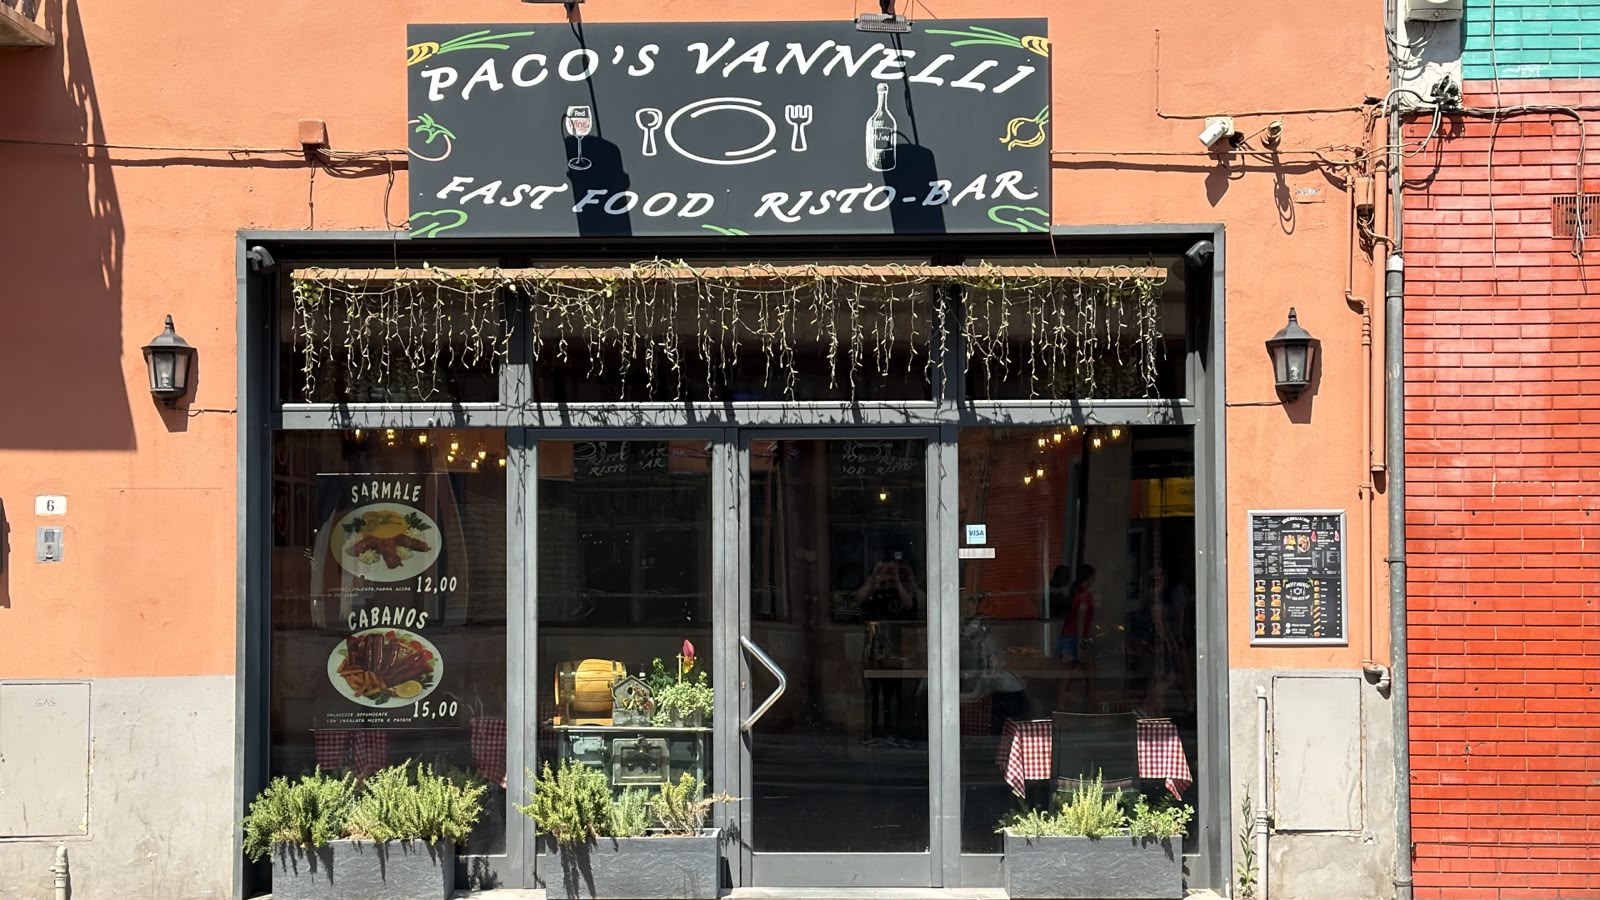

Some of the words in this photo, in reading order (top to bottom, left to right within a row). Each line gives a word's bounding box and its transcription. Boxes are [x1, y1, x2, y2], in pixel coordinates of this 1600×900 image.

[421, 44, 659, 101] PACO'S
[687, 37, 1035, 93] VANNELLI
[436, 176, 568, 210] FAST
[572, 189, 715, 218] FOOD
[754, 170, 1038, 223] RISTO-BAR
[351, 480, 422, 503] SARMALE
[46, 500, 55, 512] 6
[416, 576, 457, 594] 12,00
[347, 606, 429, 631] CABANOS
[35, 698, 56, 707] GAS
[413, 701, 458, 719] 15,00
